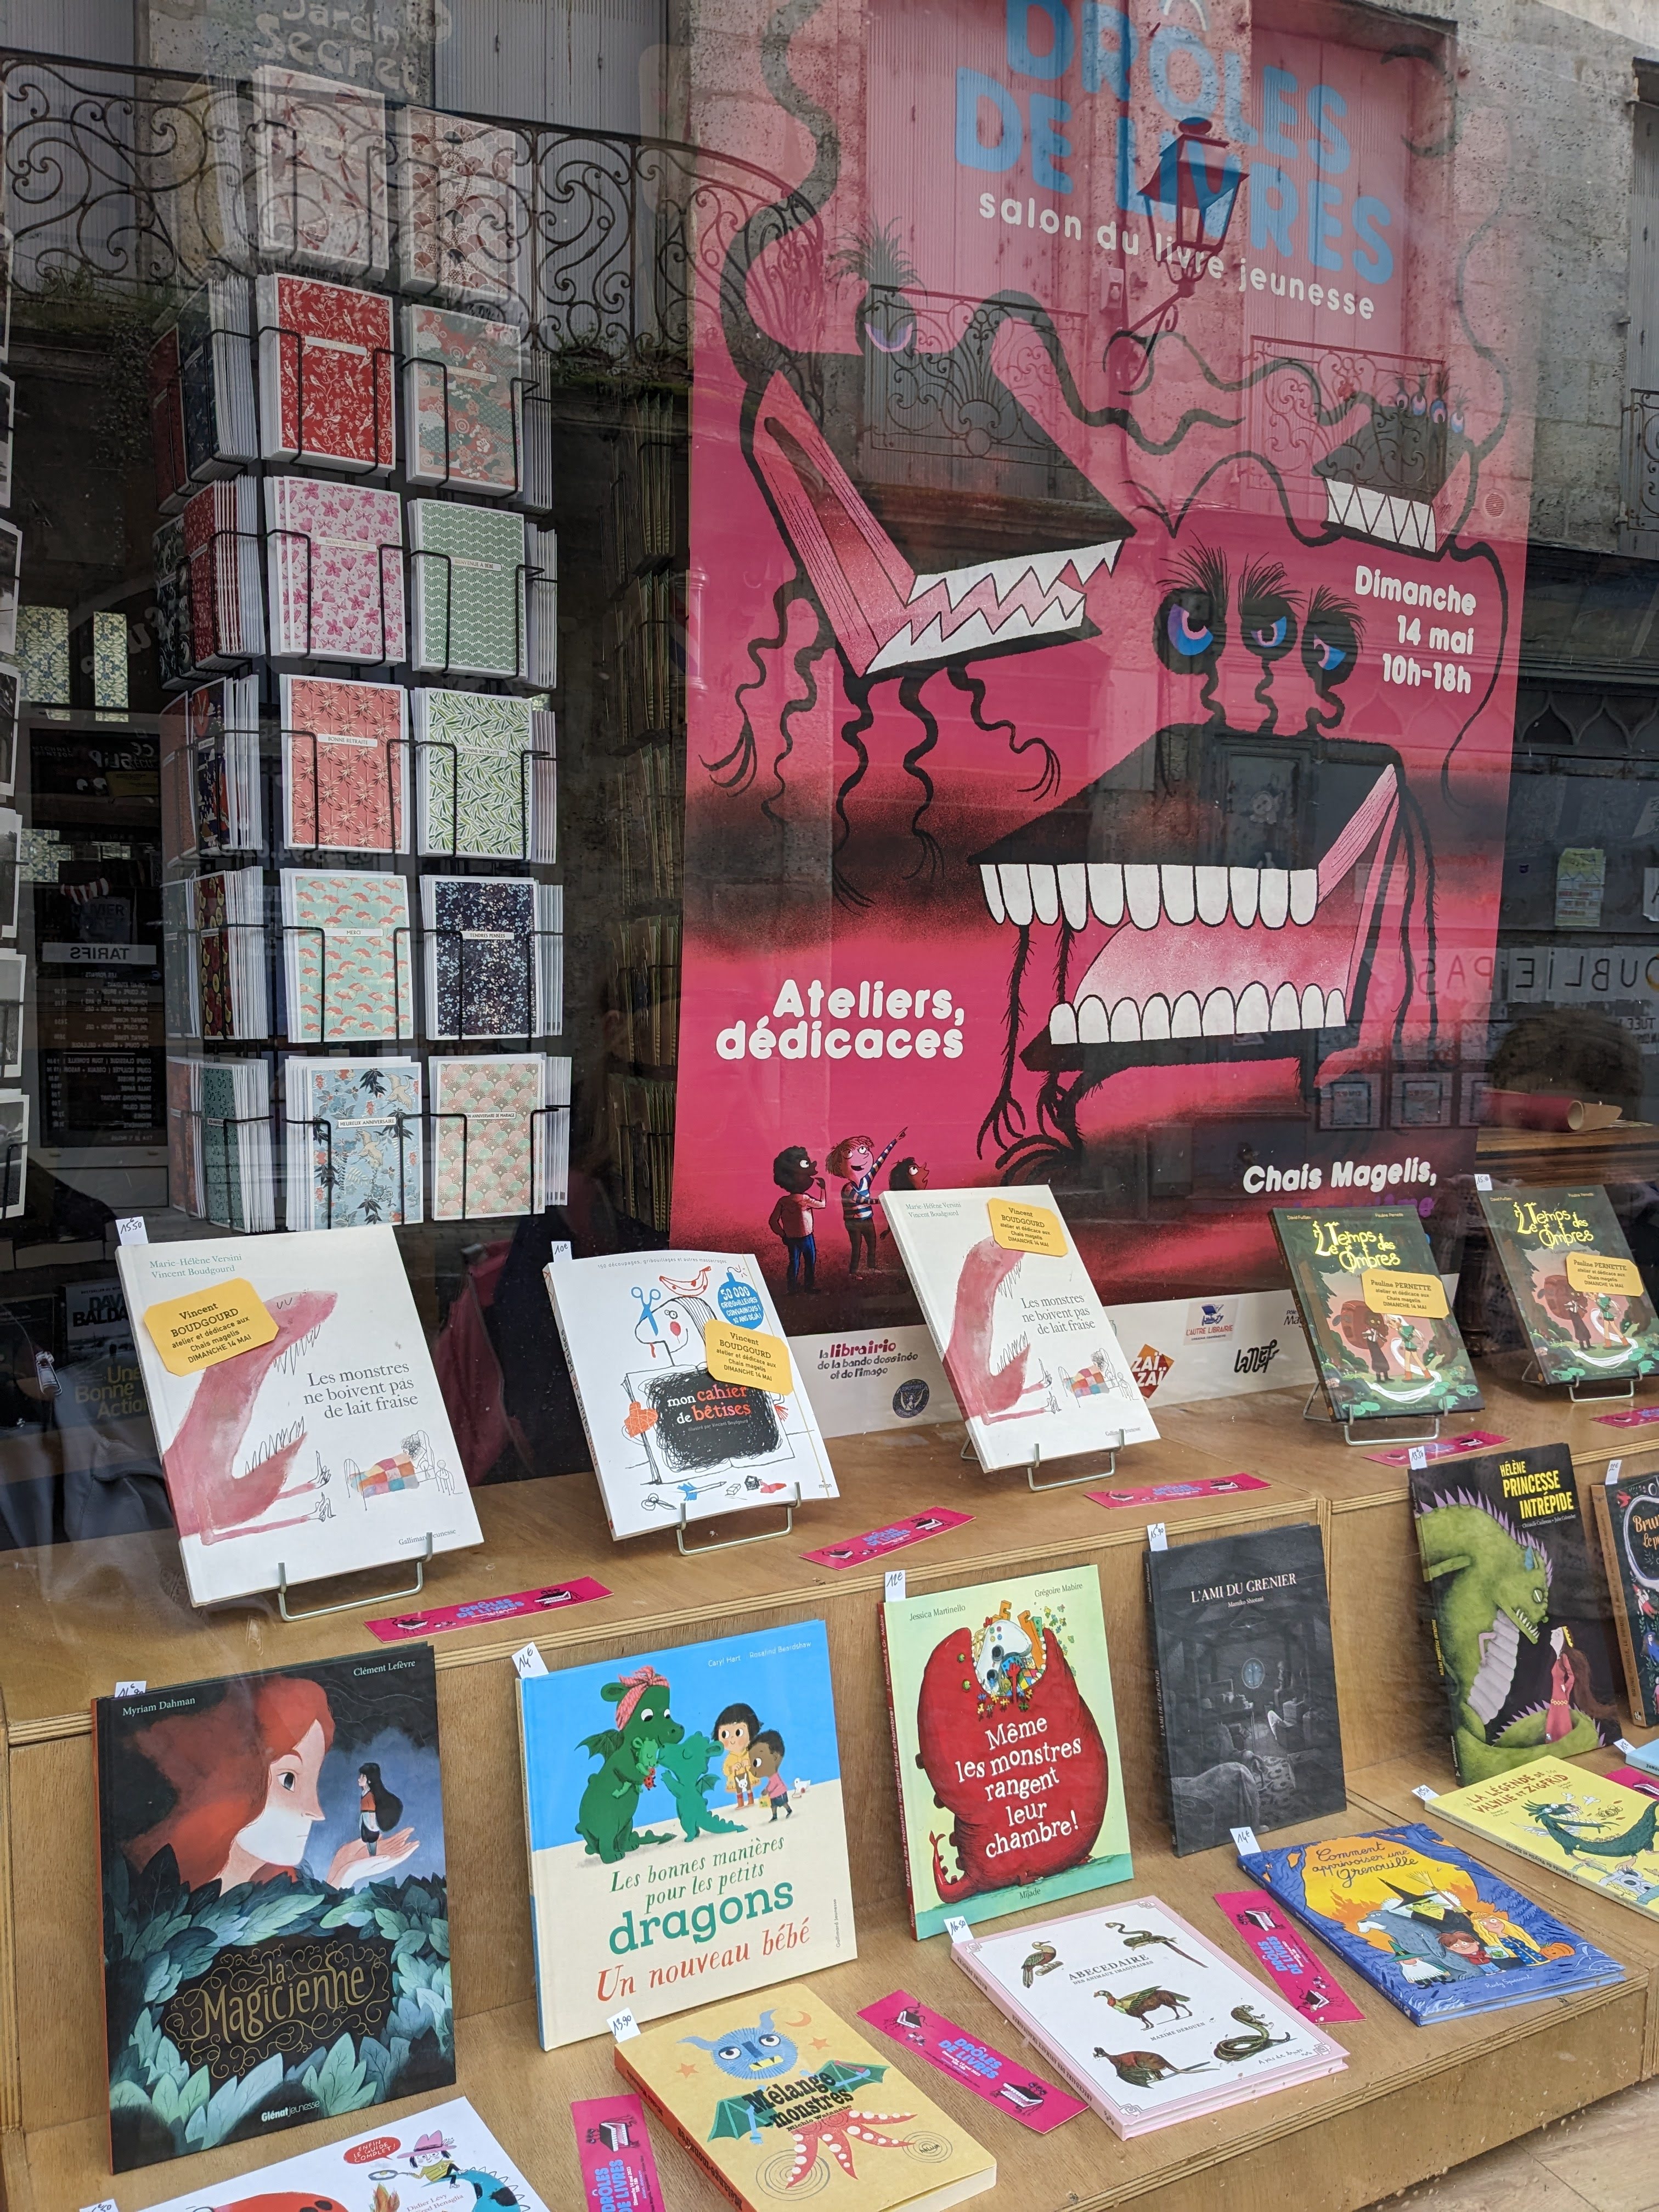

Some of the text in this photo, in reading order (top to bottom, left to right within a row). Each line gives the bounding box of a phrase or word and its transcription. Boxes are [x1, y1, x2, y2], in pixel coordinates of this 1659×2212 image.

[282, 0, 399, 51] Jardin
[253, 13, 421, 97] Secret
[955, 66, 1393, 284] DE LIVRES
[979, 192, 1374, 319] salon du livre jeunesse
[1355, 565, 1476, 616] Dimanche
[1397, 615, 1474, 654] 14 mai
[1383, 653, 1471, 693] 10h-18h
[772, 979, 965, 1026] Ateliers,
[716, 1015, 964, 1060] dédicaces
[1243, 1156, 1437, 1194] Chais Magelis,
[1324, 1221, 1376, 1247] Temps
[1378, 1233, 1395, 1251] des
[150, 1254, 242, 1268] Marie-Hélène Versini
[188, 1265, 235, 1276] Boudgourd
[1339, 1245, 1401, 1273] Ombres
[721, 1286, 750, 1300] 50 000
[1370, 1279, 1431, 1291] Pauline PERNETTE
[179, 1302, 219, 1320] Vincent
[1020, 1294, 1085, 1310] Les monstres
[1022, 1307, 1090, 1323] ne boivent pas
[171, 1308, 239, 1338] BOUDGOURD
[172, 1336, 194, 1348] atelier
[205, 1322, 235, 1337] dédicace
[237, 1316, 250, 1325] aux
[1037, 1318, 1096, 1335] de lait fraise
[1186, 1324, 1233, 1336] L'AUTRE LIBRAIRIE
[188, 1334, 252, 1363] DIMANCHE 14 MAI
[190, 1330, 240, 1352] Chais magelis
[819, 1349, 829, 1359] la
[308, 1361, 410, 1388] Les monstres
[831, 1359, 840, 1369] la
[304, 1378, 415, 1406] ne boivent pas
[324, 1392, 419, 1420] de lait fraise
[667, 1384, 748, 1408] mon cahier
[676, 1401, 752, 1425] de bêtises
[1500, 1460, 1526, 1477] HÉLÈNE
[1503, 1470, 1561, 1498] PRINCESSE
[1519, 1491, 1574, 1519] INTRÉPIDE
[1034, 1581, 1083, 1598] Grégoire Mabire
[1190, 1572, 1297, 1604] L'AMI DU GRENIER
[909, 1604, 966, 1622] Jessica Martinello
[353, 1660, 416, 1677] Clément Lefèvre
[122, 1696, 196, 1717] Myriam Dahman
[985, 1716, 1048, 1751] Même
[955, 1736, 1082, 1784] les monstres
[984, 1766, 1060, 1803] rangent
[1466, 1771, 1545, 1804] LA LÉGENDE DE
[1518, 1788, 1527, 1797] ET
[1006, 1800, 1047, 1827] leur
[609, 1835, 785, 1893] Les bonnes manières
[1312, 1849, 1410, 1878] apprivoiser une
[1316, 1841, 1386, 1861] Comment
[645, 1862, 765, 1915] pour les petits
[1019, 1887, 1041, 1900] Mijade
[609, 1881, 794, 1955] dragons
[597, 1917, 811, 2001] Un nouveau bébé
[1068, 1953, 1150, 1982] ABECEDAIRE
[1073, 1960, 1154, 1985] DES ANIMAUX IMAGINAIRES
[193, 1956, 376, 2045] Magicienne
[743, 2069, 837, 2114] Mélange
[764, 2086, 853, 2129] -monstres
[353, 2142, 388, 2158] LE GUIDE
[358, 2140, 381, 2152] ENFIN
